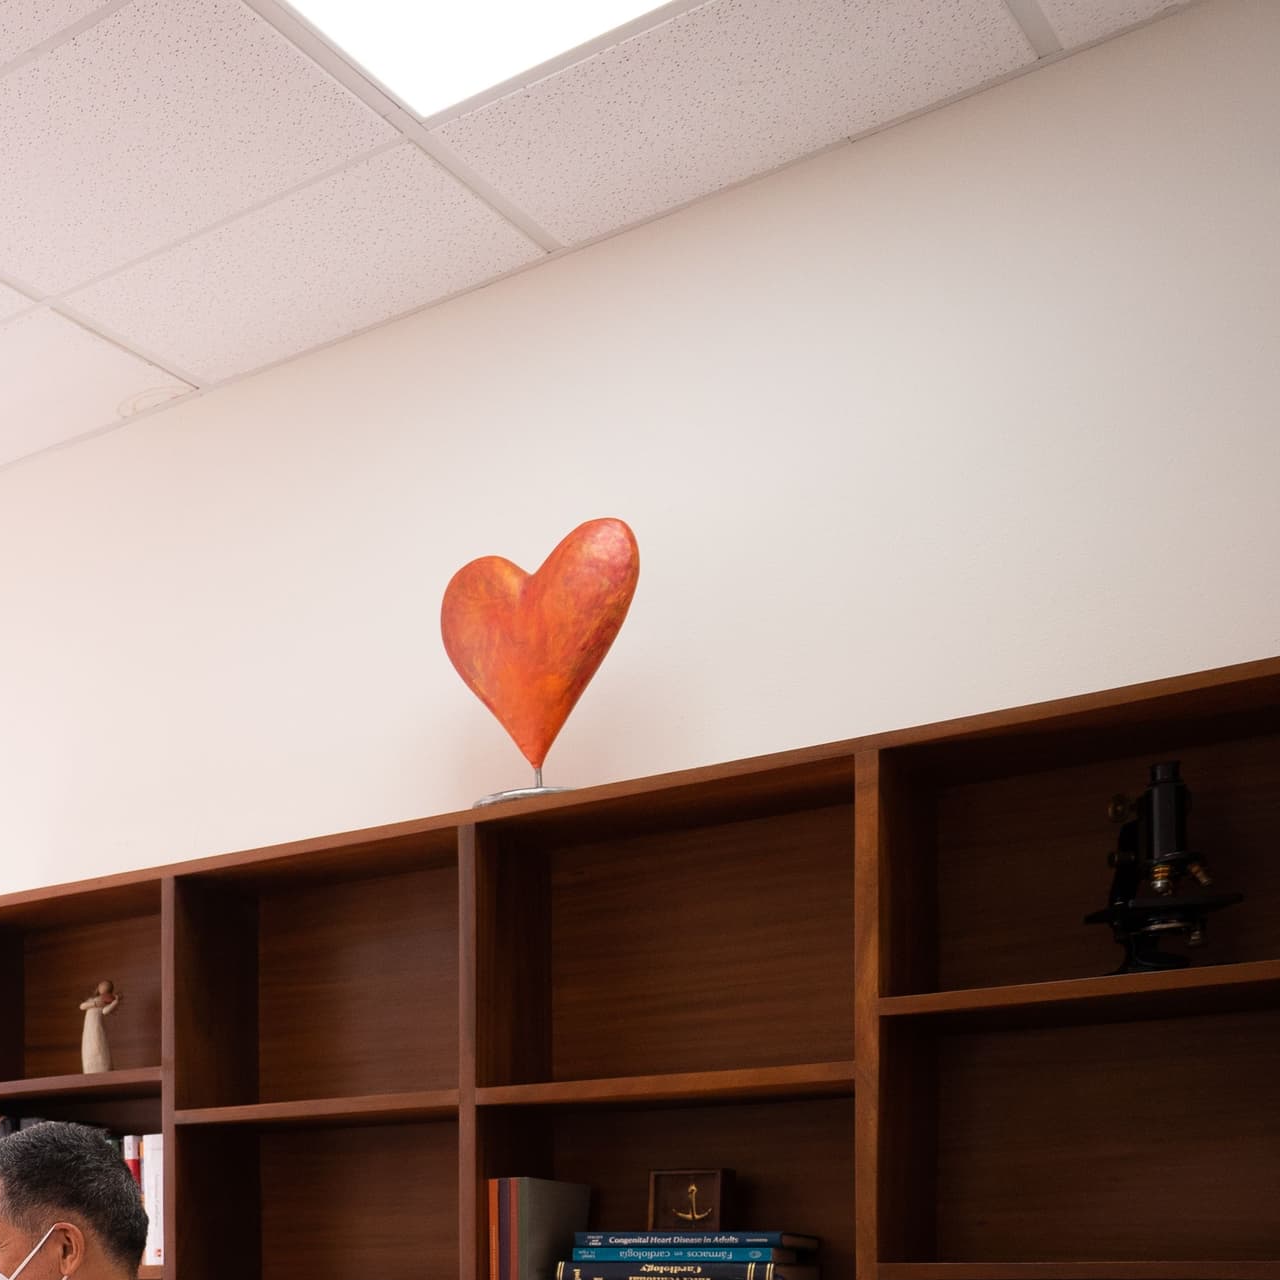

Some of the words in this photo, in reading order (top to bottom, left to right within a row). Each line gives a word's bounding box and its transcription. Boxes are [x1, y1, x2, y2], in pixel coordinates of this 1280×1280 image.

[608, 1236, 649, 1245] Congenital
[650, 1236, 673, 1244] Heart
[673, 1236, 704, 1244] Disease
[711, 1236, 739, 1244] Adults
[619, 1249, 671, 1259] cardiología
[687, 1250, 733, 1260] Fármacos
[640, 1263, 702, 1274] Cardiology
